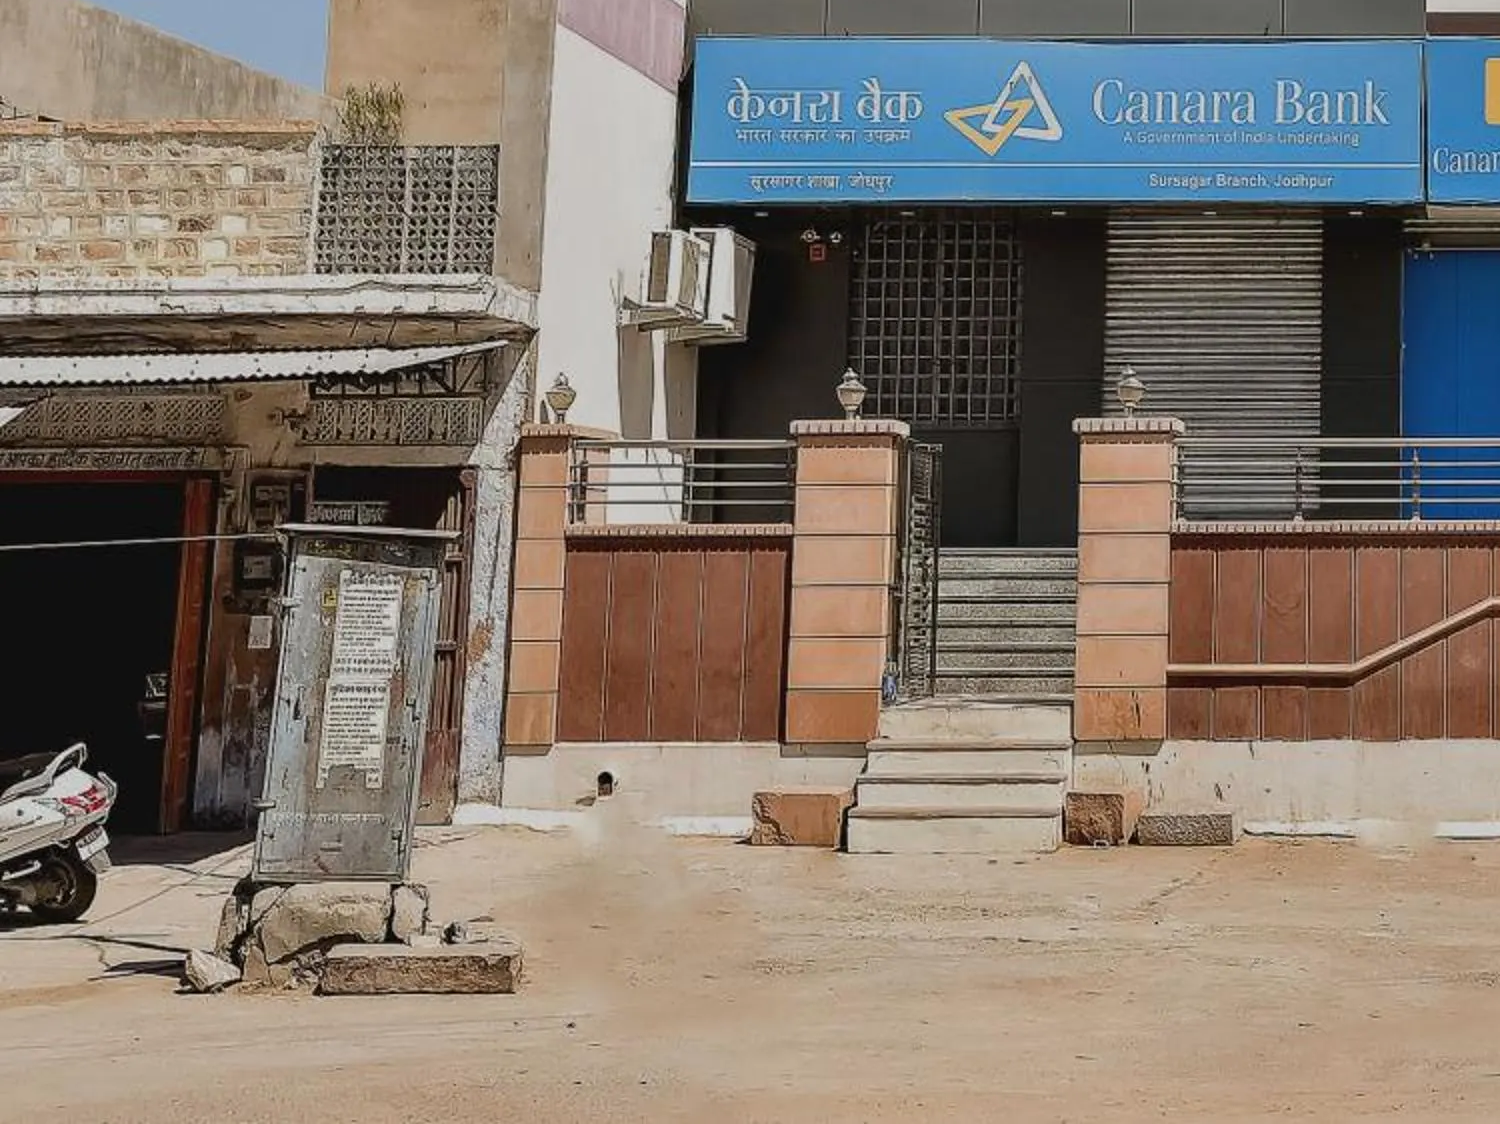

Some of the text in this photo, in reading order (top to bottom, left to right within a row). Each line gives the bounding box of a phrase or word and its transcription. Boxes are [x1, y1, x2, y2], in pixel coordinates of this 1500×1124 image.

[727, 77, 843, 123] केनरा
[1092, 78, 1391, 125] Canara Bank
[735, 128, 911, 144] भारत सरकार का उपक्रम
[1123, 132, 1360, 147] A Government of India Undertaking
[1150, 173, 1334, 189] Sursagar Branch, Jodhpur
